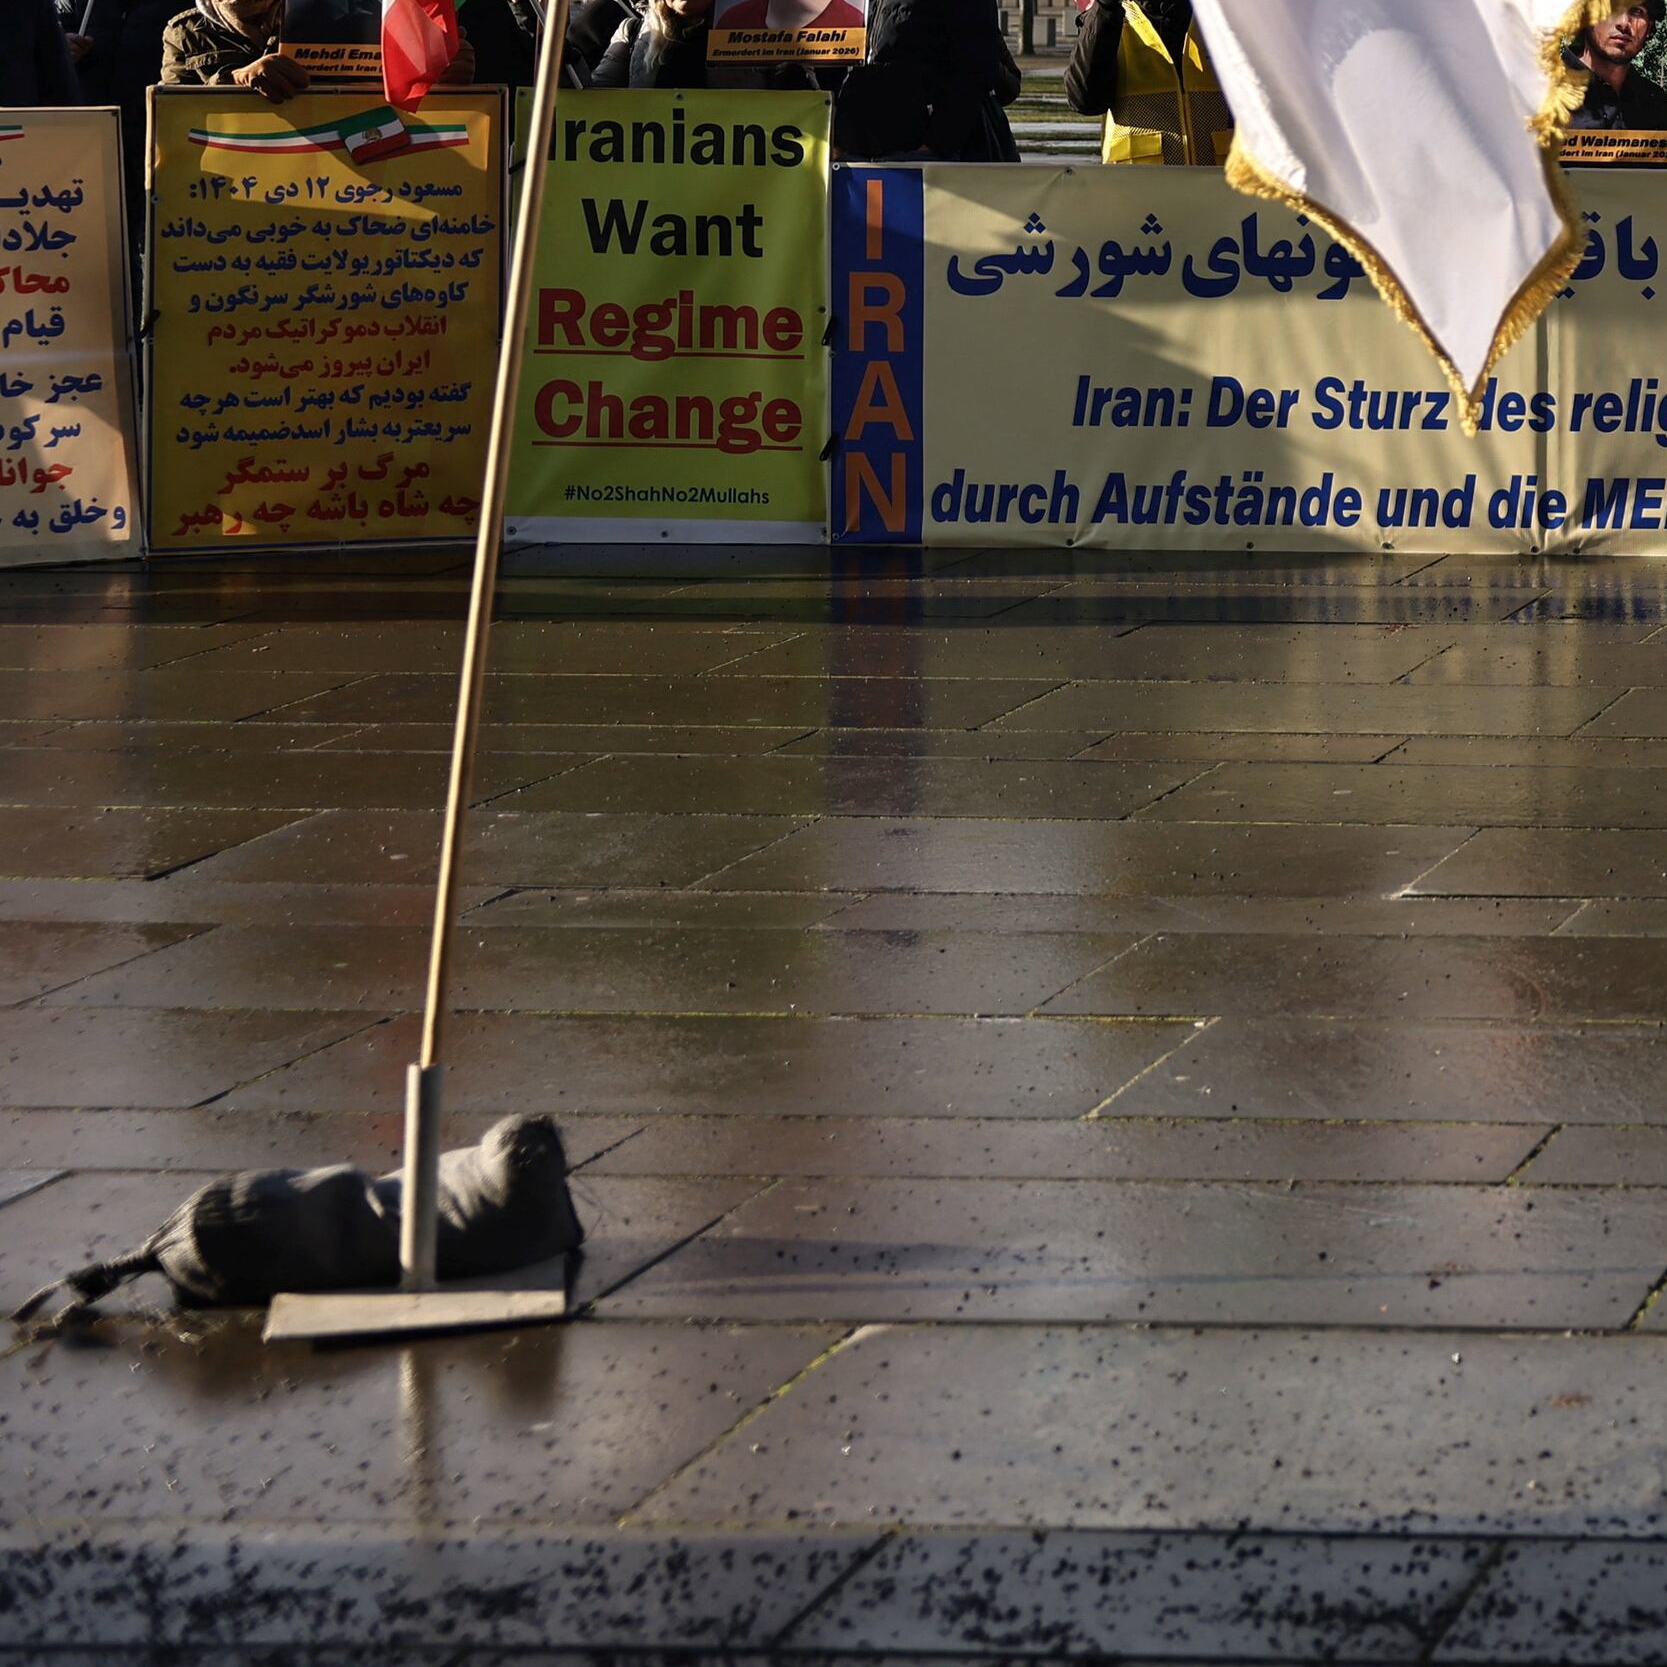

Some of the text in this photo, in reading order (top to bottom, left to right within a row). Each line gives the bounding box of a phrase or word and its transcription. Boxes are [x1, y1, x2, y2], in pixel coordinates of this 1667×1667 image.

[728, 30, 847, 43] Mostafa Falahi
[295, 48, 345, 60] Mehdi
[713, 47, 762, 57] Ermordert
[797, 47, 831, 56] (Januar
[832, 47, 860, 56] 2026)
[547, 107, 805, 167] Iranians
[265, 181, 298, 204] دی
[334, 181, 393, 204] رجوی
[400, 181, 463, 198] مسعود
[581, 198, 764, 258] Want
[173, 254, 226, 272] دست
[946, 212, 1174, 298] شورشی
[537, 287, 804, 362] Regime
[376, 349, 431, 377] ایران
[843, 178, 914, 533] IRAN
[244, 386, 291, 408] است
[1073, 374, 1193, 428] Iran:
[1206, 375, 1300, 429] Der
[1311, 376, 1450, 431] Sturz
[1477, 377, 1556, 433] des
[533, 378, 803, 455] Change
[320, 461, 349, 490] بر
[378, 489, 430, 518] شاه
[564, 484, 770, 505] #No2ShahNo2Mullahs
[931, 468, 1082, 525] durch
[1091, 470, 1363, 529] Aufstände
[1375, 473, 1478, 530] und
[1486, 474, 1567, 531] die
